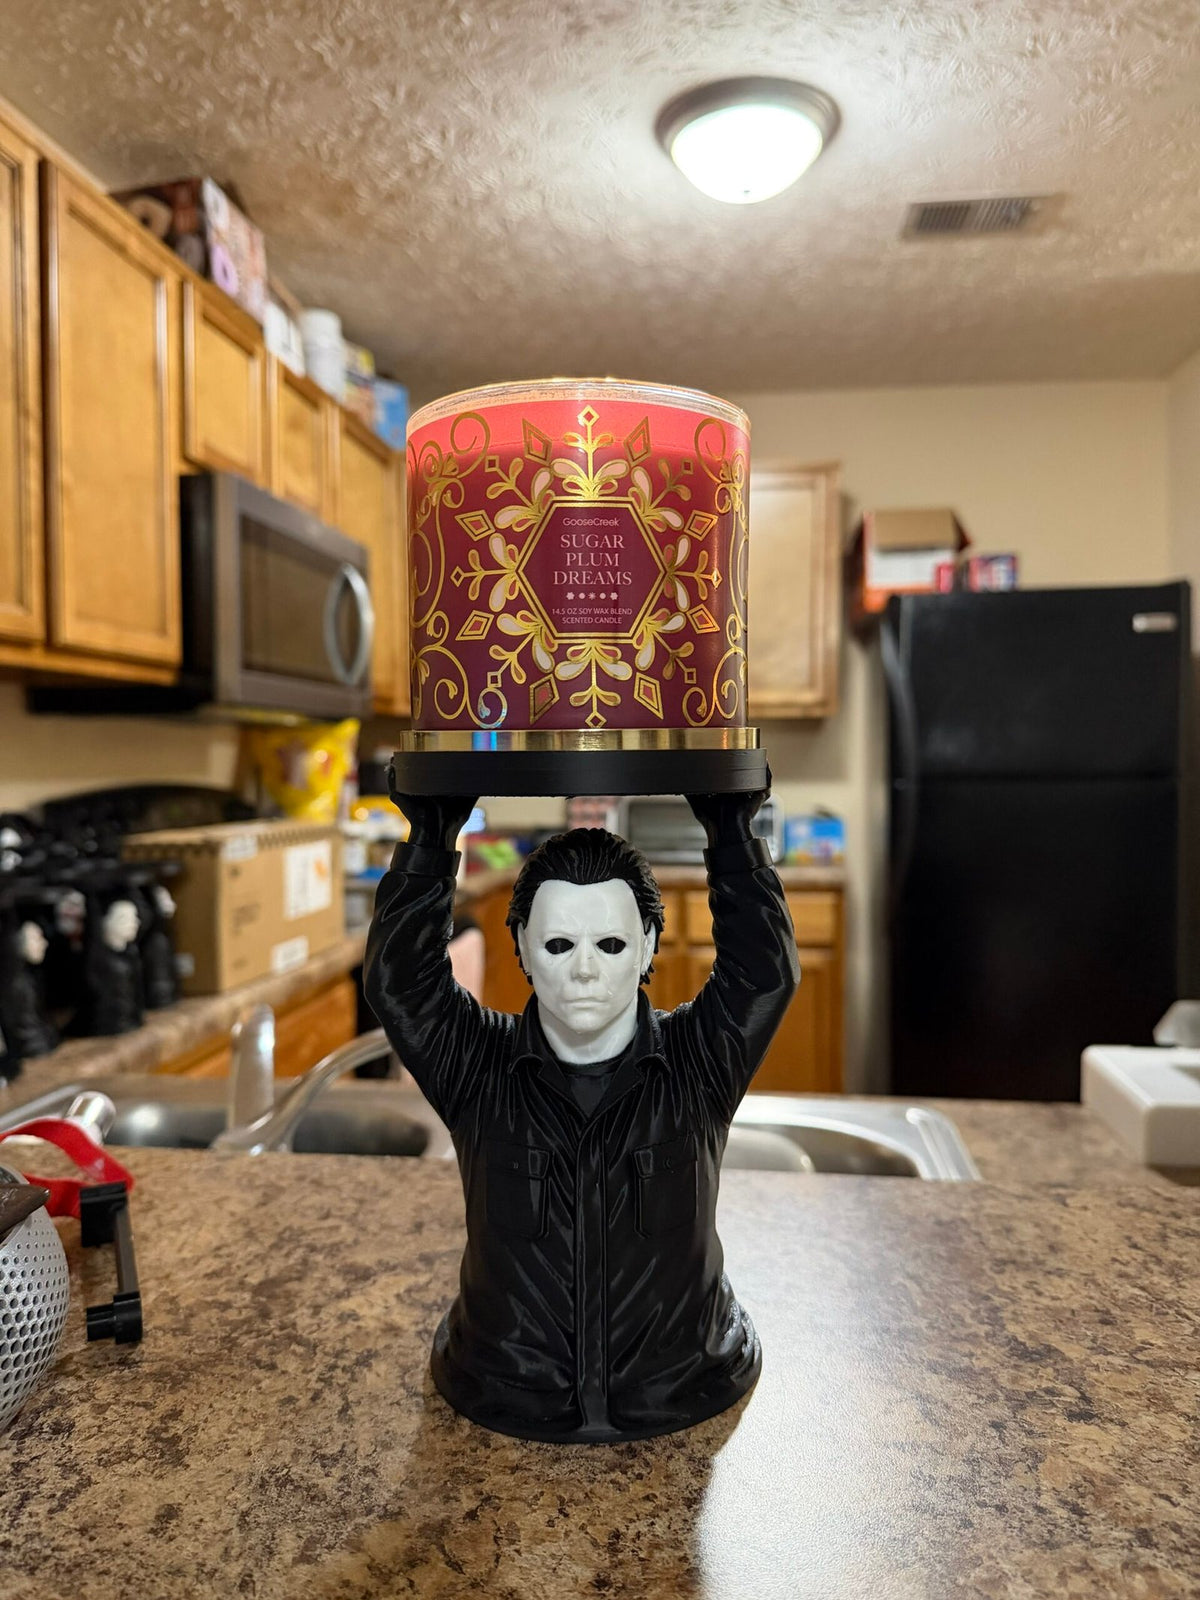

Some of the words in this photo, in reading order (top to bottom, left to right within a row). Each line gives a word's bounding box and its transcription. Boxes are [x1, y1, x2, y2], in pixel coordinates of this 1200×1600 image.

[563, 517, 620, 527] GooseCreek
[560, 534, 625, 549] SUGAR
[566, 552, 619, 567] PLUM
[553, 571, 632, 585] DREAMS
